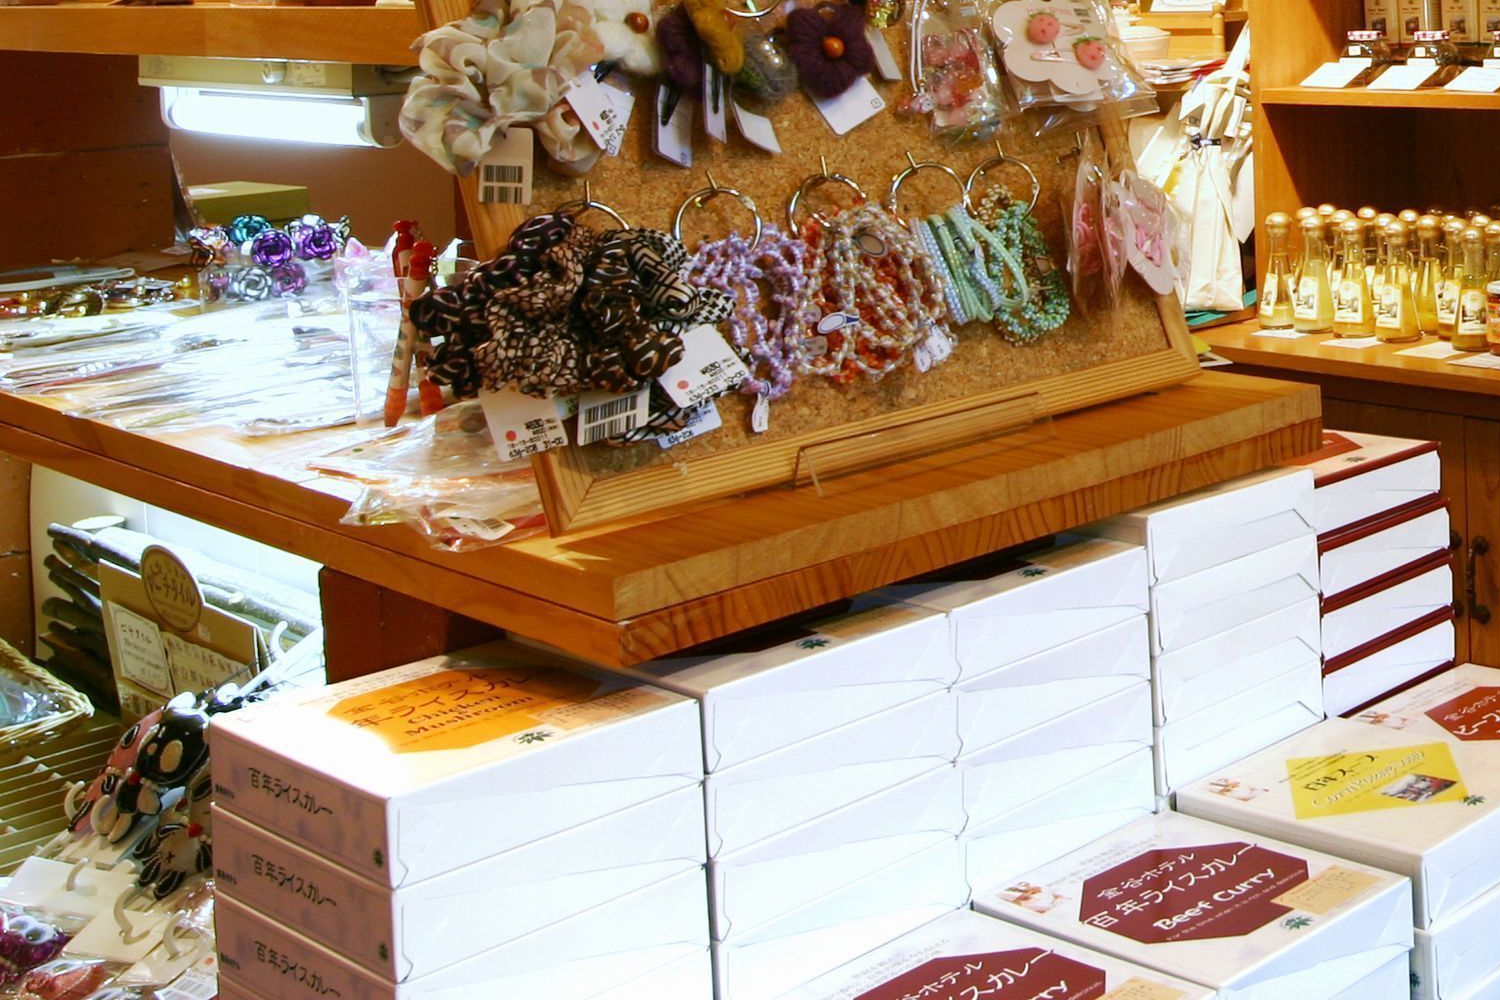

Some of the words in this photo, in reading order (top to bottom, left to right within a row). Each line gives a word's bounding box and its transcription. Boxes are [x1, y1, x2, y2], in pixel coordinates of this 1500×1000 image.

[351, 667, 557, 729] 年ライスカレー
[404, 695, 536, 738] Mushroom
[408, 694, 501, 725] Chicken
[248, 767, 334, 815] 百年ライスカレー
[251, 854, 339, 907] 百年ライスカレー
[1078, 843, 1258, 929] 百年ライスカレー
[1097, 852, 1197, 900] 金谷ホテル
[1153, 900, 1214, 932] Beef
[1213, 867, 1276, 903] Curry
[254, 940, 342, 998] 百年ライスカレー
